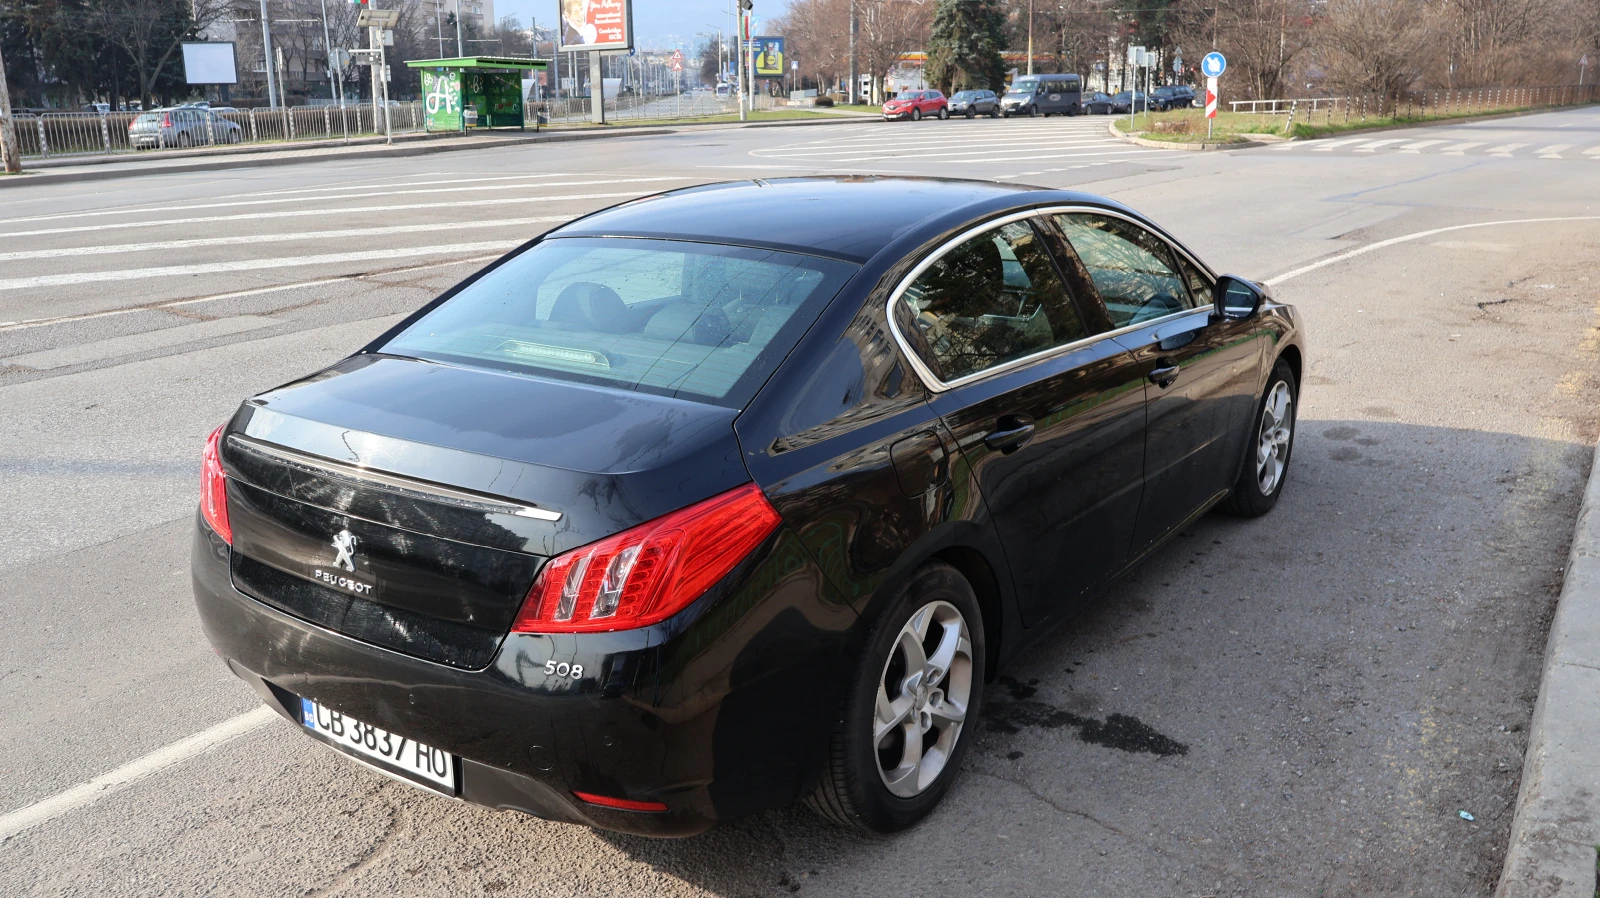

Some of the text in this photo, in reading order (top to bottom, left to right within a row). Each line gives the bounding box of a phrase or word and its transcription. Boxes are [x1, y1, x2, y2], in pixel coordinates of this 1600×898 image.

[598, 27, 622, 35] Cambridge
[315, 569, 373, 594] PEUGEOT
[543, 659, 584, 680] 508
[304, 711, 314, 723] BG
[316, 703, 447, 778] CB 3837 HO
